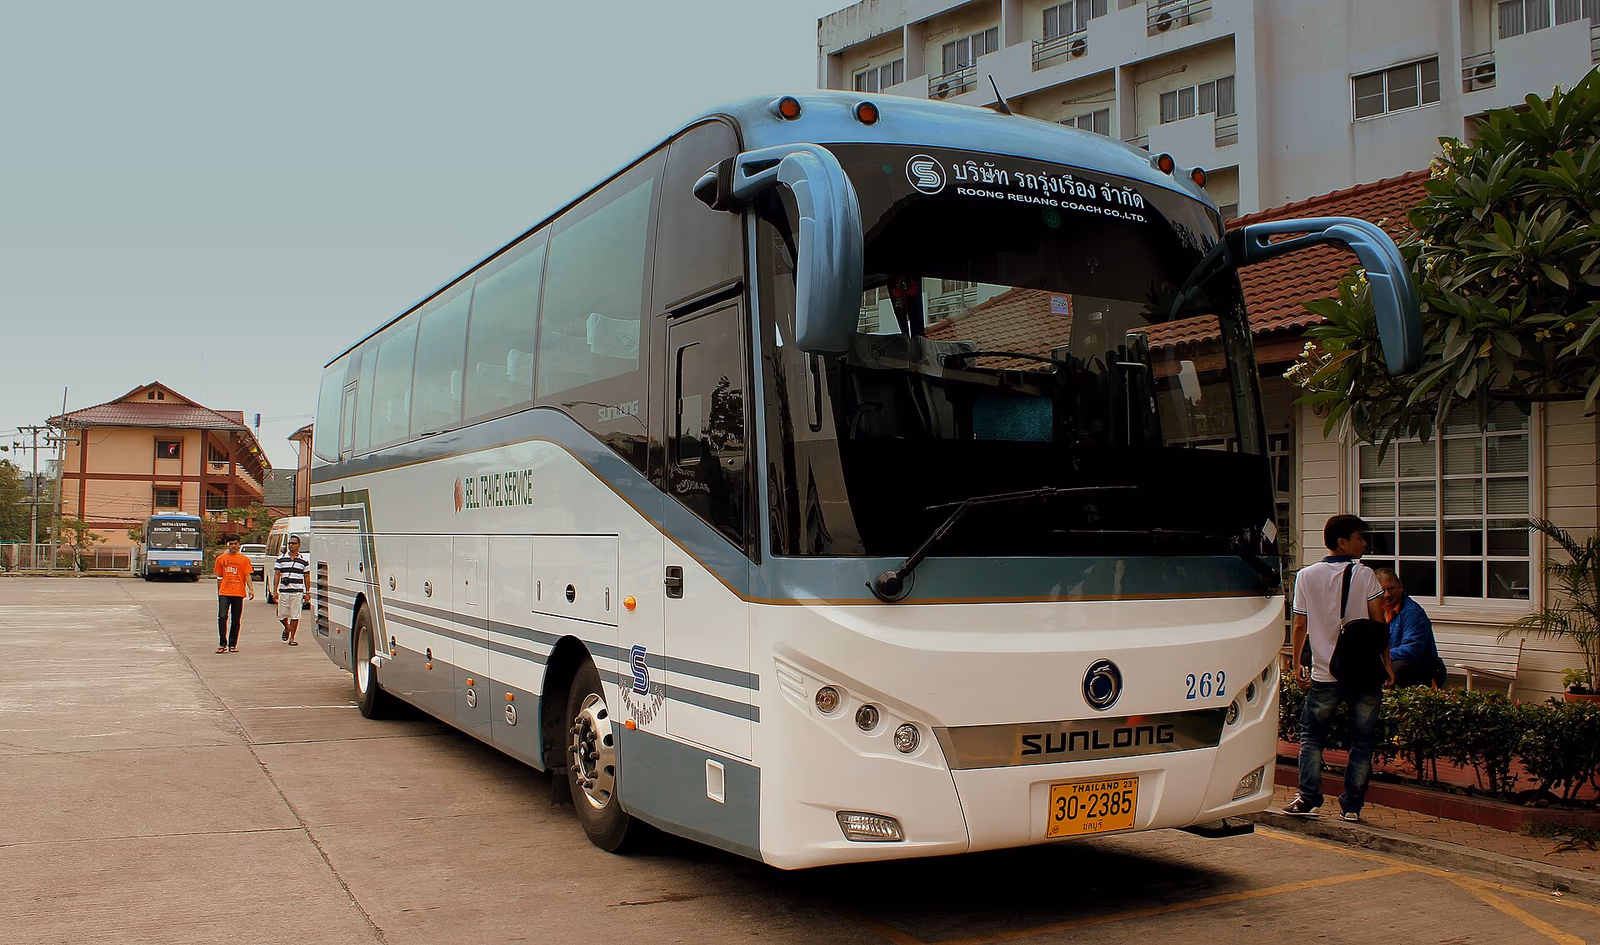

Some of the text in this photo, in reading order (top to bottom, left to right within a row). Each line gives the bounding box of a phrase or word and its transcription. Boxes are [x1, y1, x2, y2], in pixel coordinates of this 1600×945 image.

[953, 160, 1145, 209] บริษัท รถรุ่งเรือง จำกัด
[957, 187, 1148, 223] ROONG REUANG COACH CO.,LTD.
[466, 469, 533, 508] BELL TRAVEL SERVICE
[1185, 670, 1226, 700] 262
[1021, 724, 1175, 755] SUNLONG
[1072, 781, 1119, 793] THAILAND
[1055, 790, 1133, 822] 30-2385
